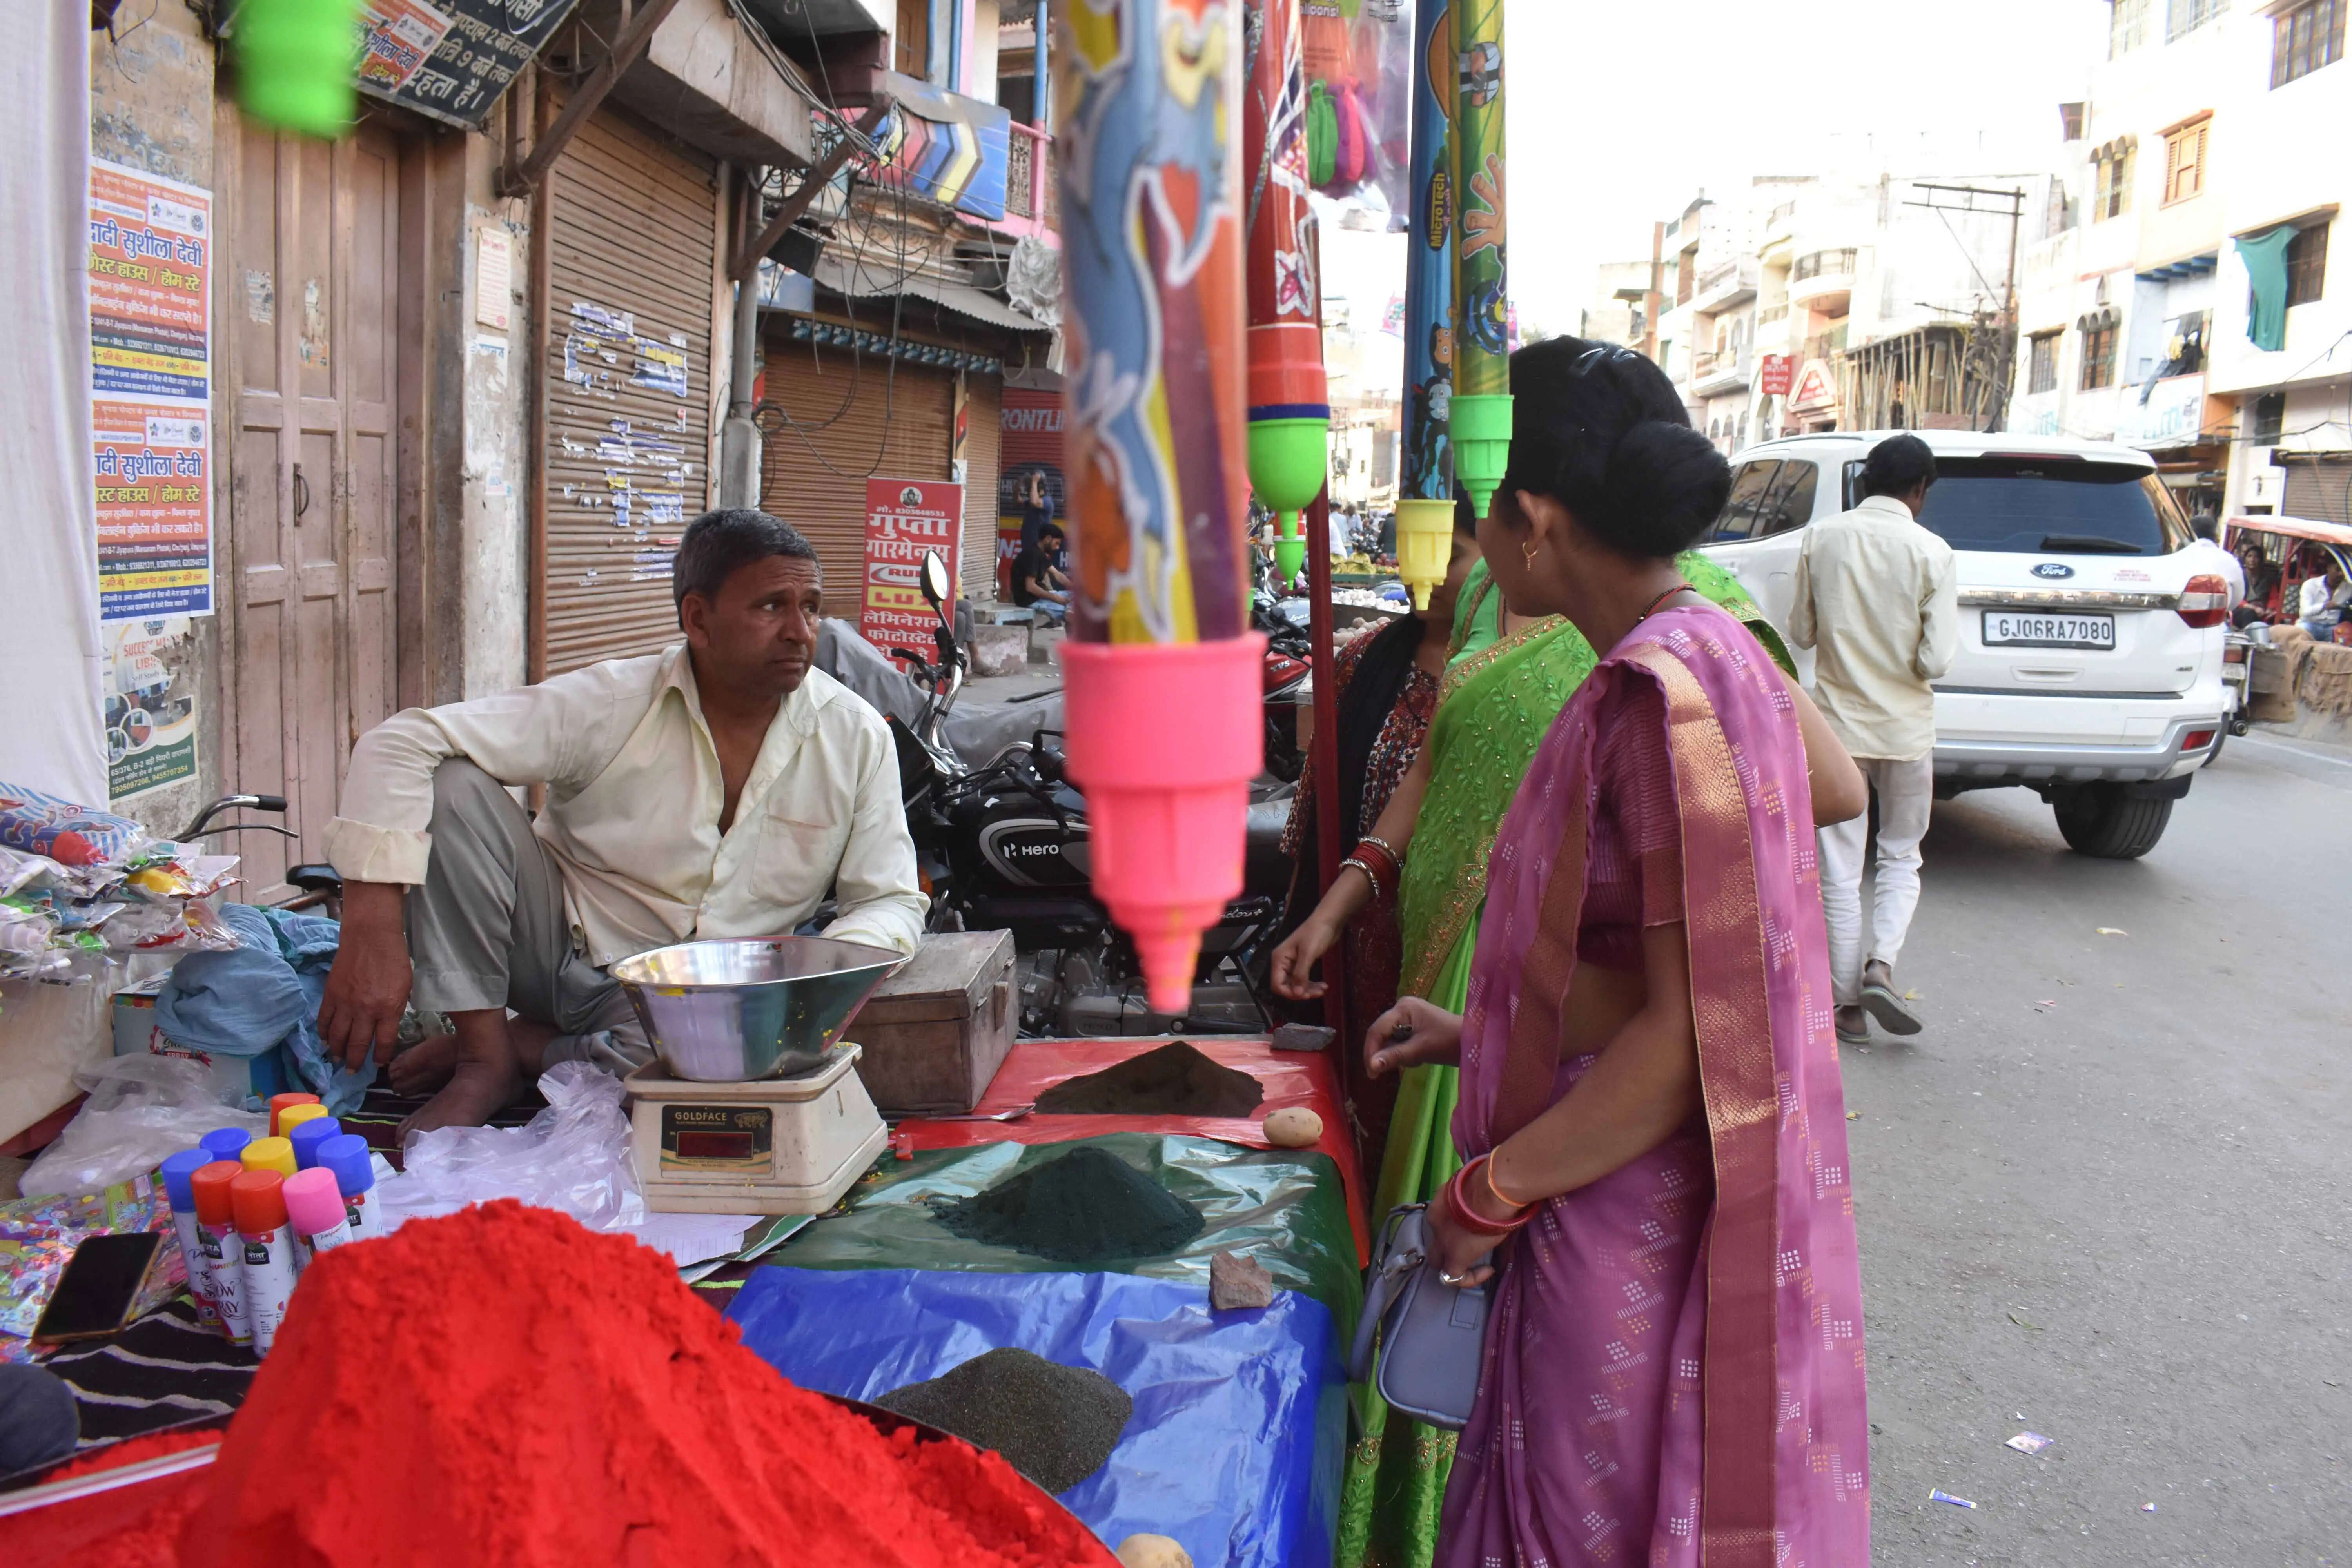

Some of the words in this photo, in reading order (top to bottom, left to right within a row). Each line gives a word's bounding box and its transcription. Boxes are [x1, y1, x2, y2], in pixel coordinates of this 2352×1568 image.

[485, 28, 499, 45] 2
[457, 51, 473, 67] 9
[471, 55, 498, 78] बजे
[123, 229, 172, 259] सुशीला
[176, 237, 203, 267] देवी
[118, 261, 149, 281] हाउस
[161, 268, 182, 288] होम
[185, 273, 201, 292] स्टे
[1001, 408, 1063, 431] RONTLI
[122, 450, 173, 483] सुशीला
[176, 452, 201, 476] देवी
[118, 487, 149, 503] हाउस
[162, 484, 183, 503] होम
[185, 485, 201, 502] स्टे
[161, 525, 174, 533] कर
[869, 513, 951, 539] गुप्ता
[2041, 564, 2067, 575] Ford
[863, 610, 943, 628] लेमिनेशन
[2000, 619, 2111, 640] GJ06RA7080
[1022, 844, 1059, 856] Hero
[675, 1112, 727, 1121] GOLDFACE
